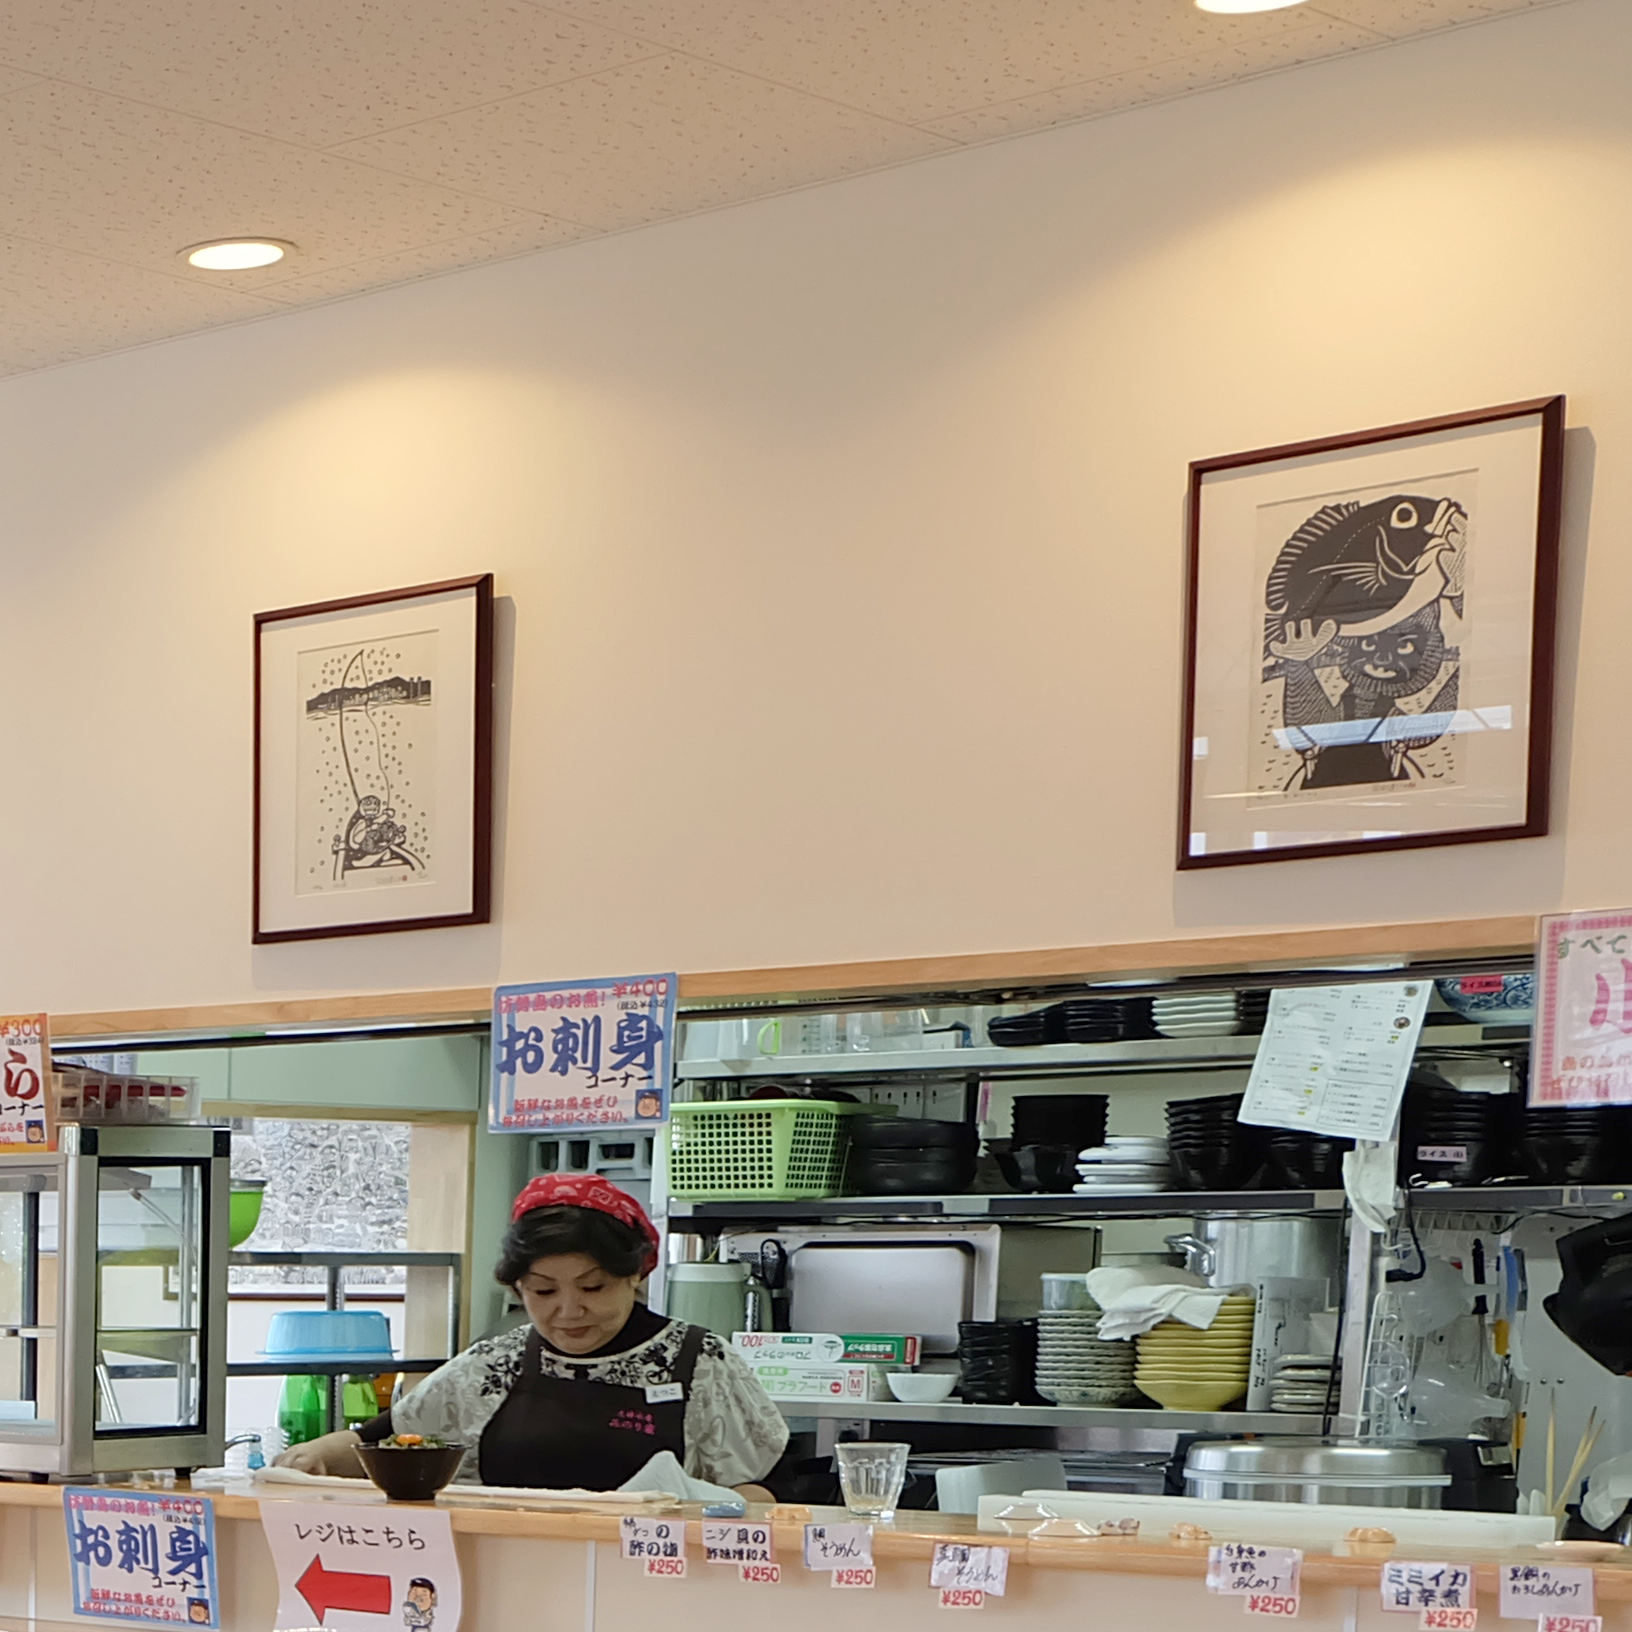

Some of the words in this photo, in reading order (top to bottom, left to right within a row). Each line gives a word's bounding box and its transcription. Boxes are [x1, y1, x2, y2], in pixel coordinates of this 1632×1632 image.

[612, 978, 668, 998] ¥400
[496, 1012, 664, 1076] お刺身
[586, 1071, 653, 1089] コーナー
[851, 1379, 861, 1390] M
[293, 1520, 426, 1550] レジはこちら
[73, 1520, 209, 1580] お刺身
[820, 1537, 861, 1559] そうめん
[647, 1559, 684, 1575] ¥250
[742, 1565, 780, 1583] ¥250
[152, 1576, 207, 1592] コーナー
[835, 1569, 874, 1586] ¥250
[1387, 1567, 1468, 1588] ミミイカ
[941, 1589, 983, 1607] ¥250
[1248, 1595, 1297, 1616] ¥250
[1424, 1609, 1476, 1629] ¥250
